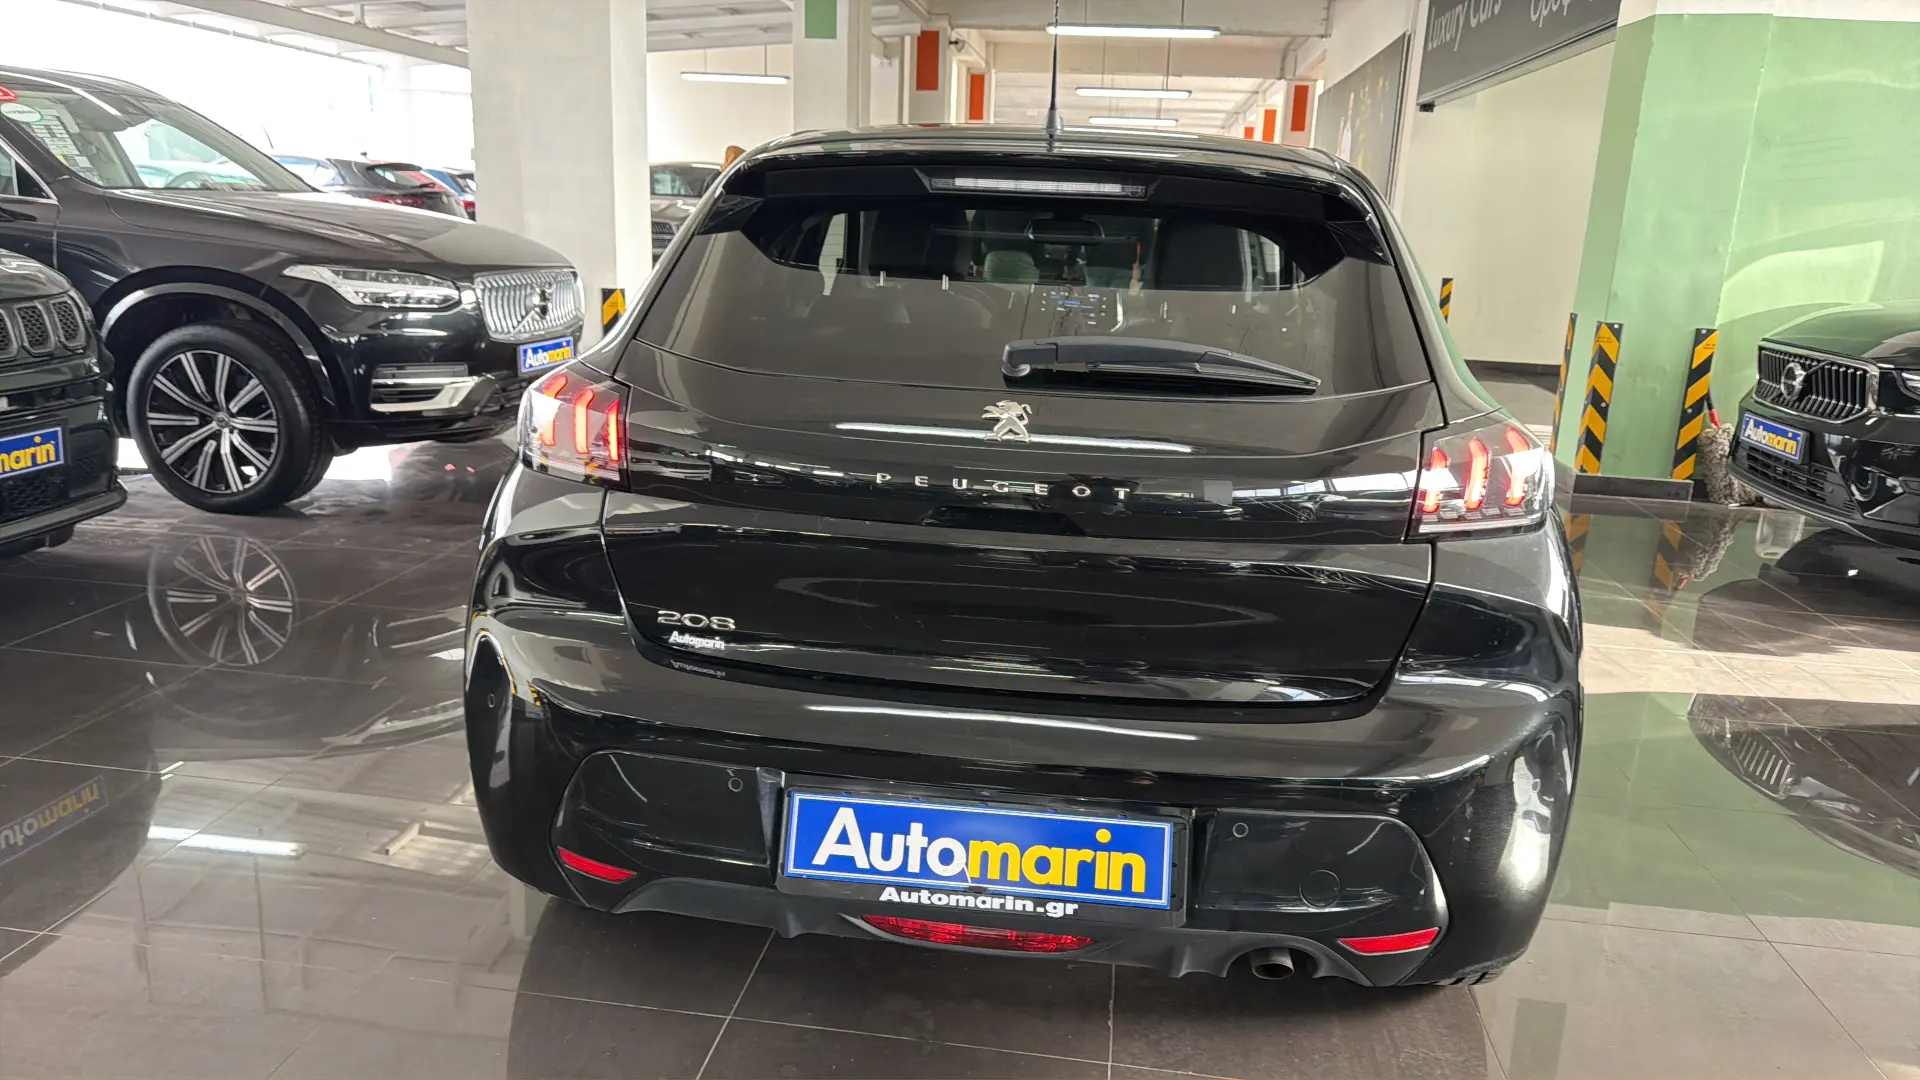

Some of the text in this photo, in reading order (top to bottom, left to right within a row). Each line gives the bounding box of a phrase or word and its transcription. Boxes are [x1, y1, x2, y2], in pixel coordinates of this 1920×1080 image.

[1428, 2, 1468, 52] Luxury
[525, 341, 571, 368] Automarin
[1744, 418, 1797, 455] Automarin
[876, 472, 1130, 500] PEUGEOT
[657, 610, 736, 631] 208
[668, 630, 725, 650] Automarin
[811, 807, 1146, 892] Automarin
[879, 886, 1079, 917] Automarin.gr
